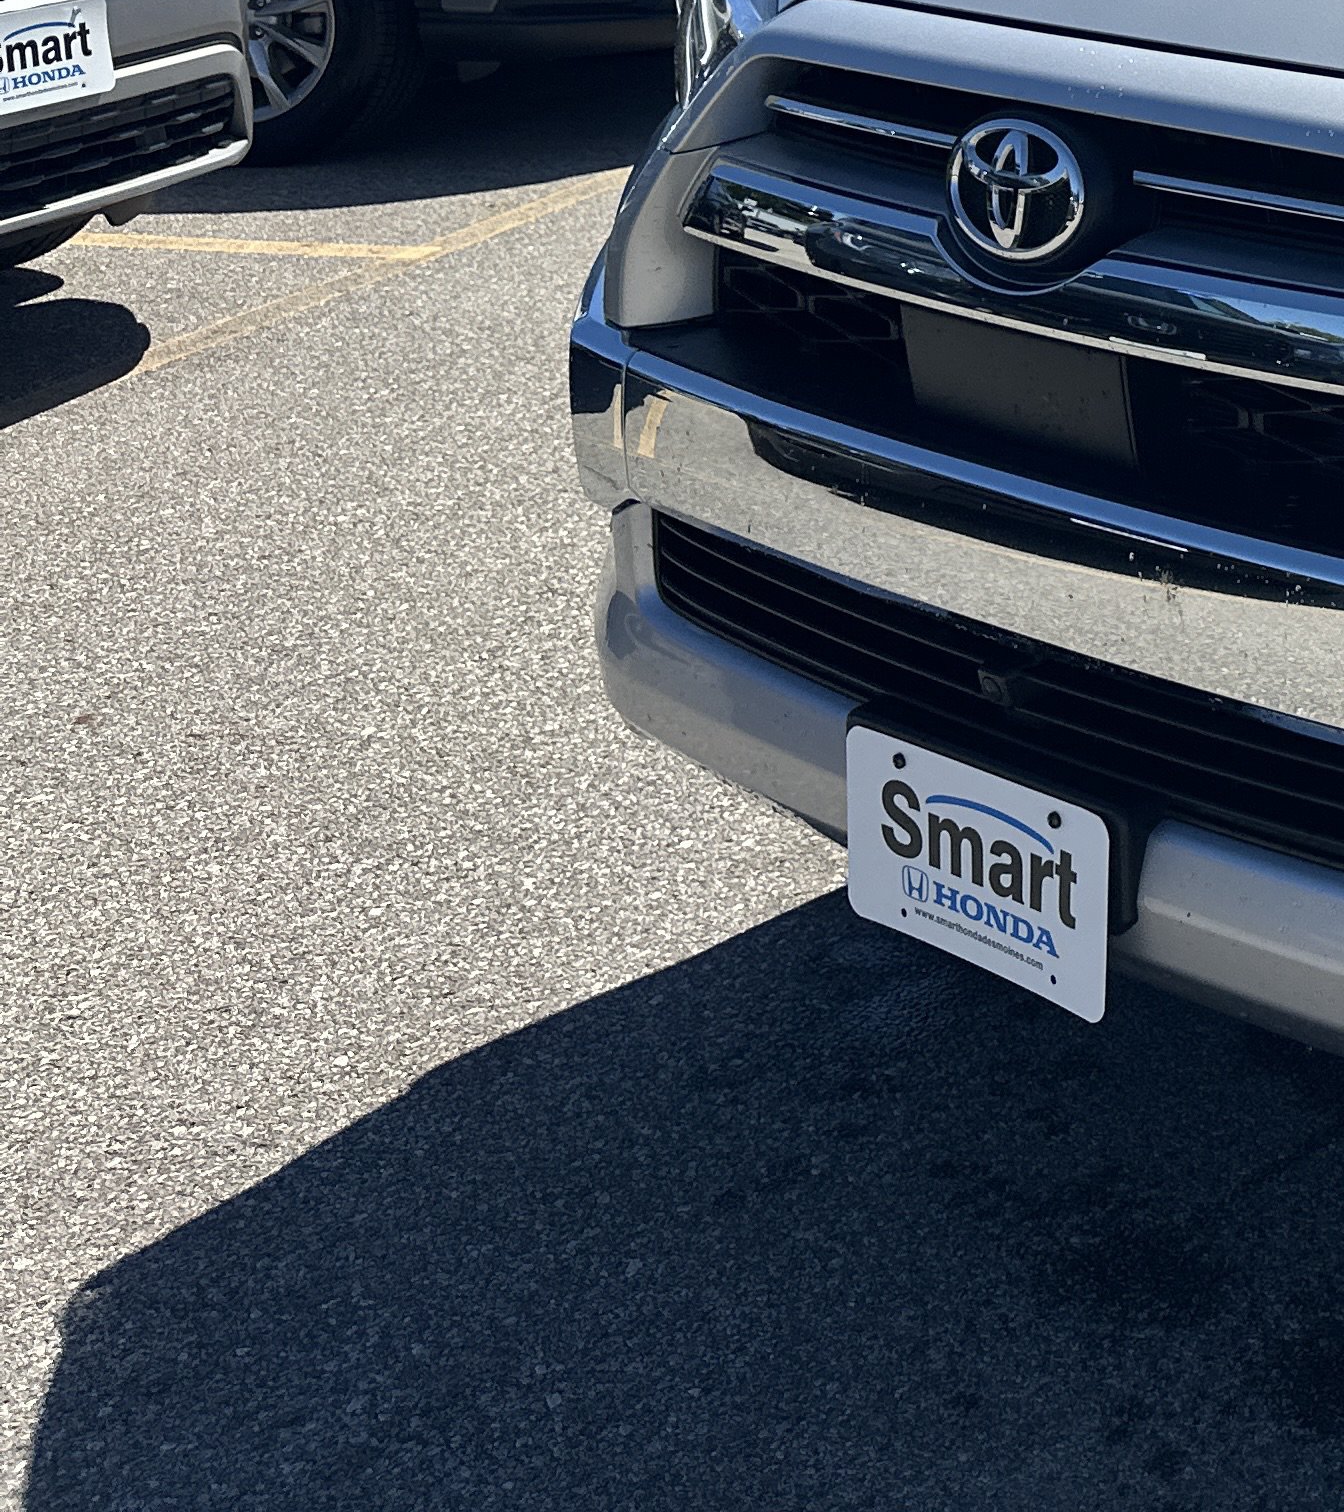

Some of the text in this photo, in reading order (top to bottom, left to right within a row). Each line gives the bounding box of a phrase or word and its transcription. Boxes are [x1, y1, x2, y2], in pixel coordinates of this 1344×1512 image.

[0, 21, 92, 73] mart
[12, 64, 86, 90] HONDA
[881, 779, 1078, 930] Smart
[914, 906, 1044, 971] www.smarthondadesmoines.com
[933, 880, 1060, 959] HONDA
